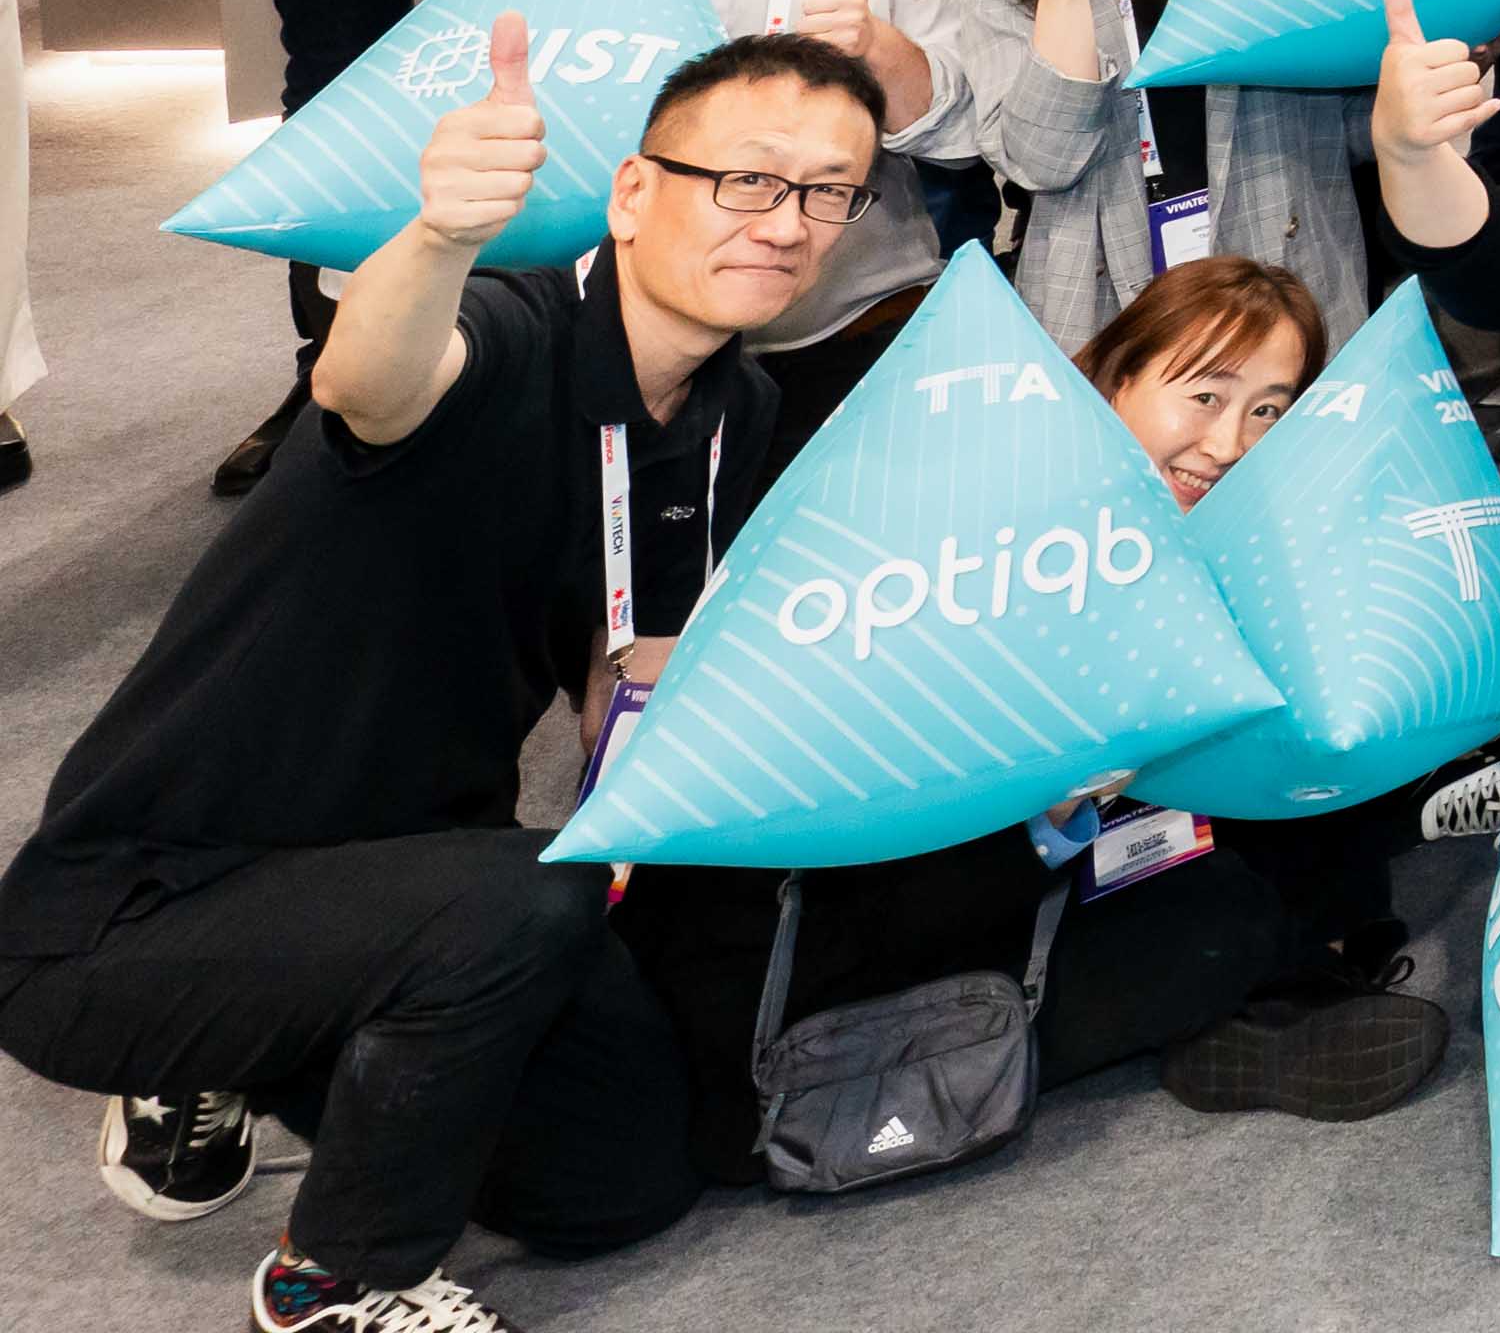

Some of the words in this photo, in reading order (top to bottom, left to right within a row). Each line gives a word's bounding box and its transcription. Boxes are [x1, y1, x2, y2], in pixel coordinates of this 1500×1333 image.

[1166, 194, 1209, 214] VIVATEC
[914, 361, 1061, 418] TTA
[611, 495, 624, 555] VIVATECH
[777, 506, 1154, 661] optiqb
[867, 1133, 914, 1154] adidas
